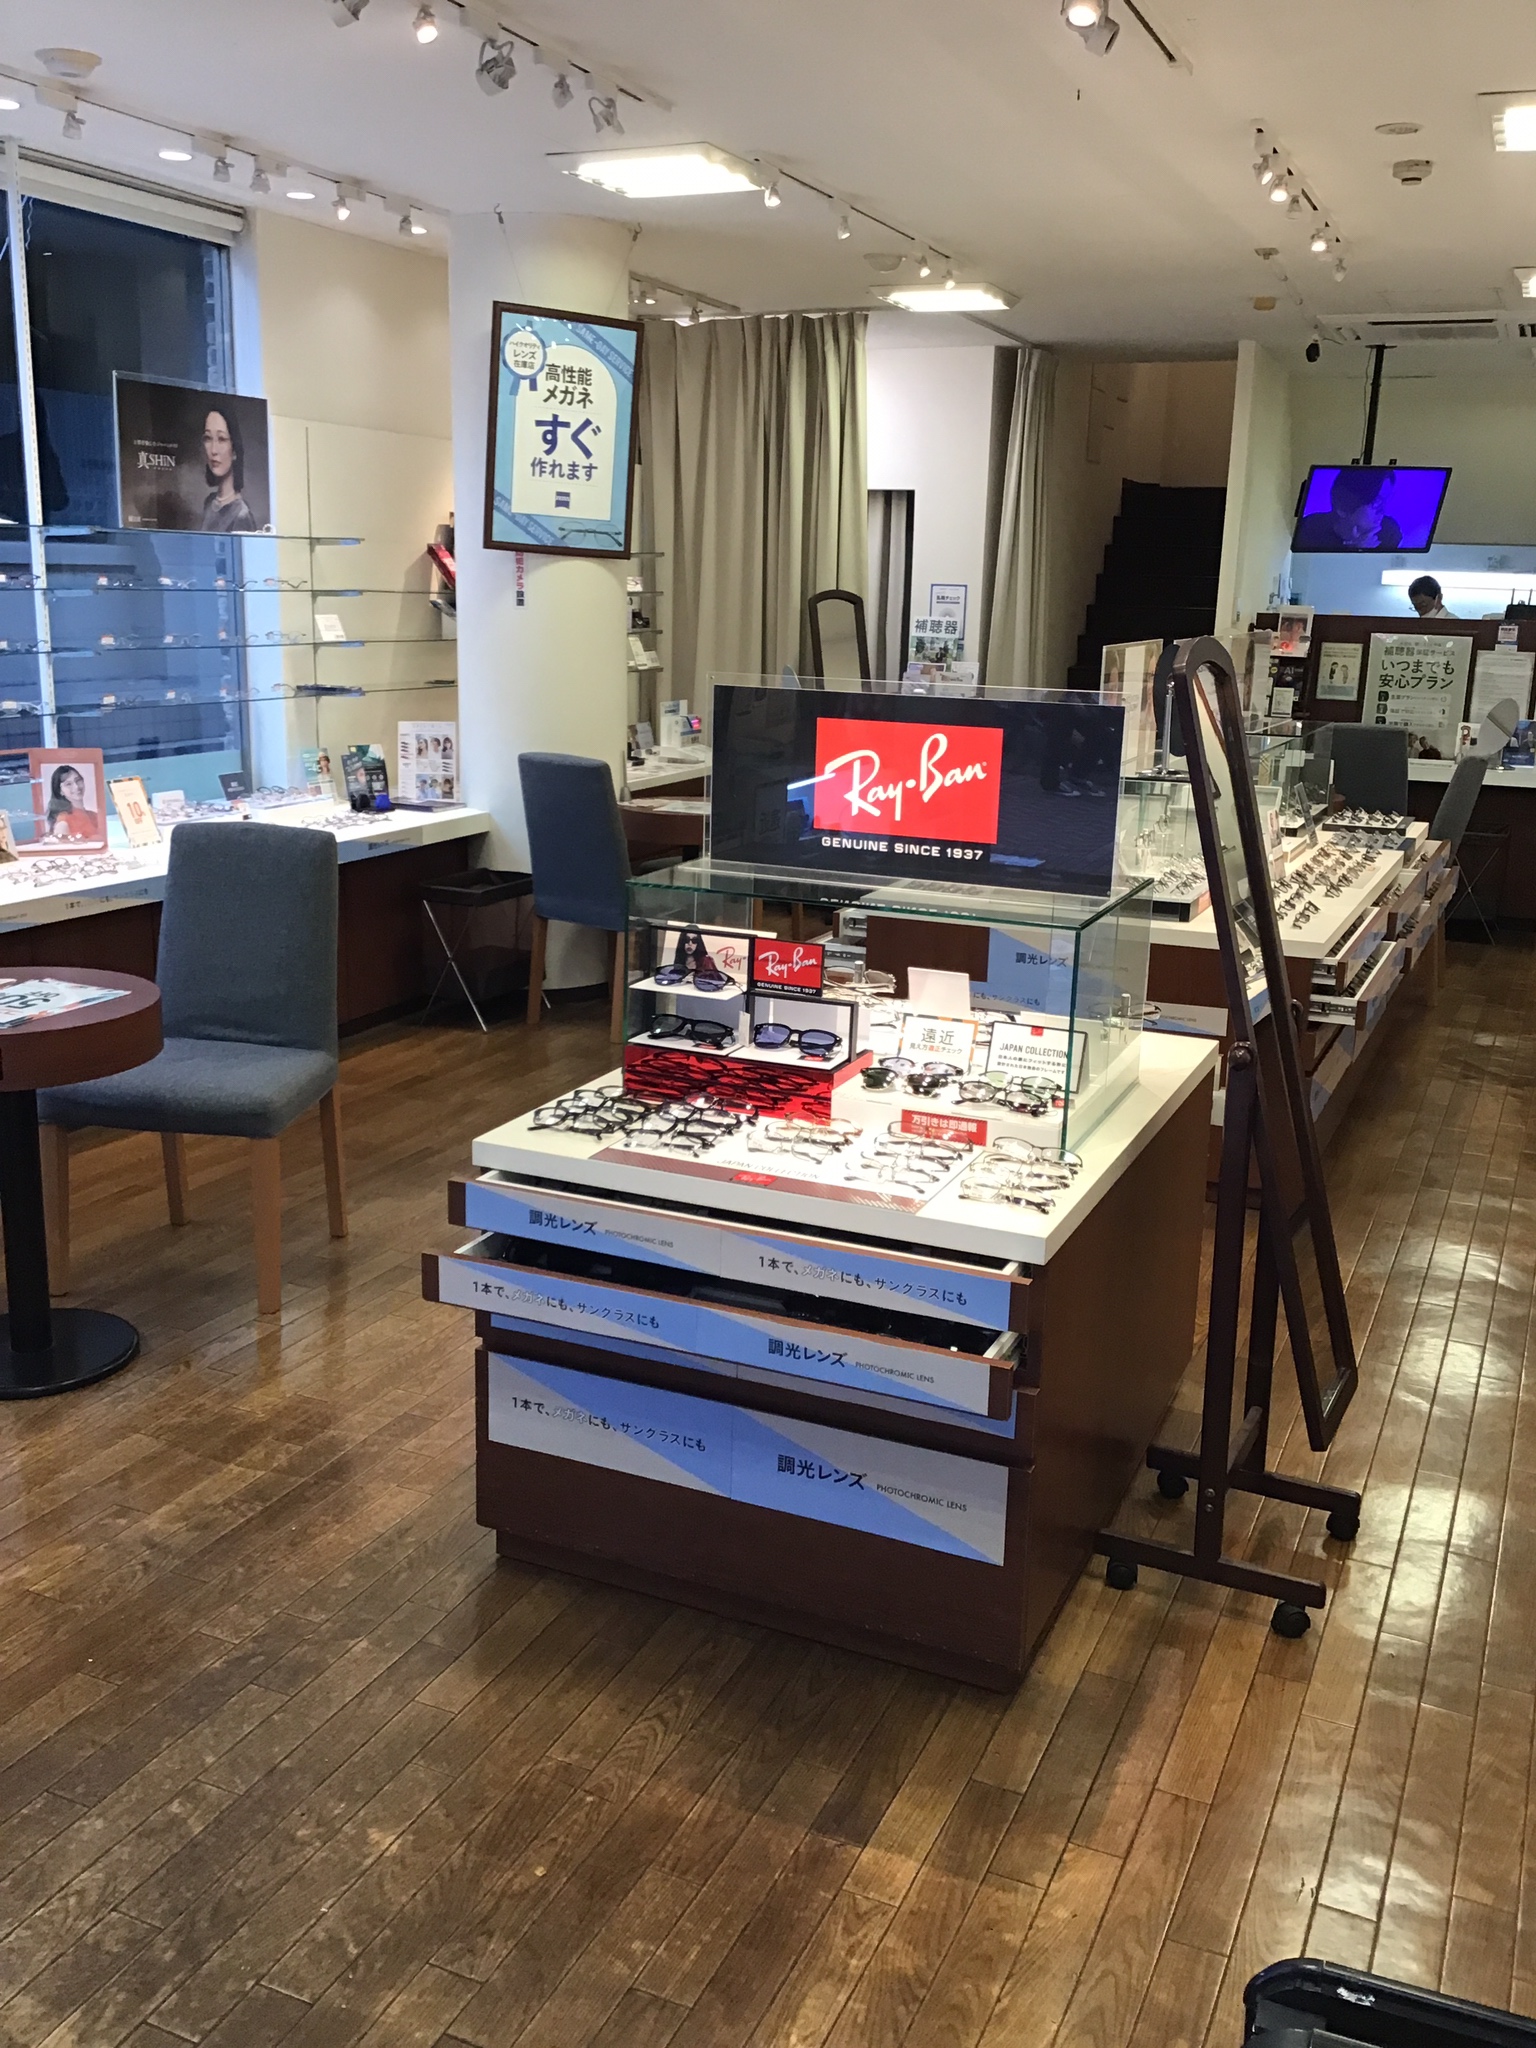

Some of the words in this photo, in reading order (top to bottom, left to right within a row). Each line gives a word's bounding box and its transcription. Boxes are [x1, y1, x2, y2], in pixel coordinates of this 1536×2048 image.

[513, 349, 537, 360] レンズ
[545, 363, 593, 387] 高性能
[543, 385, 593, 409] メガネ
[535, 413, 602, 459] すぐ
[530, 457, 598, 482] 作れます
[915, 619, 958, 635] 補聴器
[1381, 659, 1455, 675] いつまでも
[1378, 673, 1454, 690] 安心プラン
[821, 836, 888, 853] GENUINE
[894, 842, 941, 857] SINCE
[946, 847, 984, 861] 1937
[1015, 952, 1069, 968] 調光レンズ
[757, 981, 783, 990] GENUINE
[784, 985, 801, 994] SINCE
[921, 1027, 955, 1046] 遠近
[1000, 1042, 1023, 1053] JAPAN
[1024, 1045, 1069, 1059] COLLECTION
[528, 1209, 598, 1236] 調光レンズ
[604, 1228, 657, 1245] PHOTOCHROMIC
[658, 1240, 674, 1249] LENS
[768, 1338, 848, 1368] 調光レンズ
[855, 1360, 915, 1380] PHOTOCHROMIC
[916, 1373, 935, 1384] LENS
[777, 1453, 868, 1491] 調光レンズ
[876, 1483, 944, 1507] PHOTOCHROMIC
[946, 1500, 968, 1513] LENS
